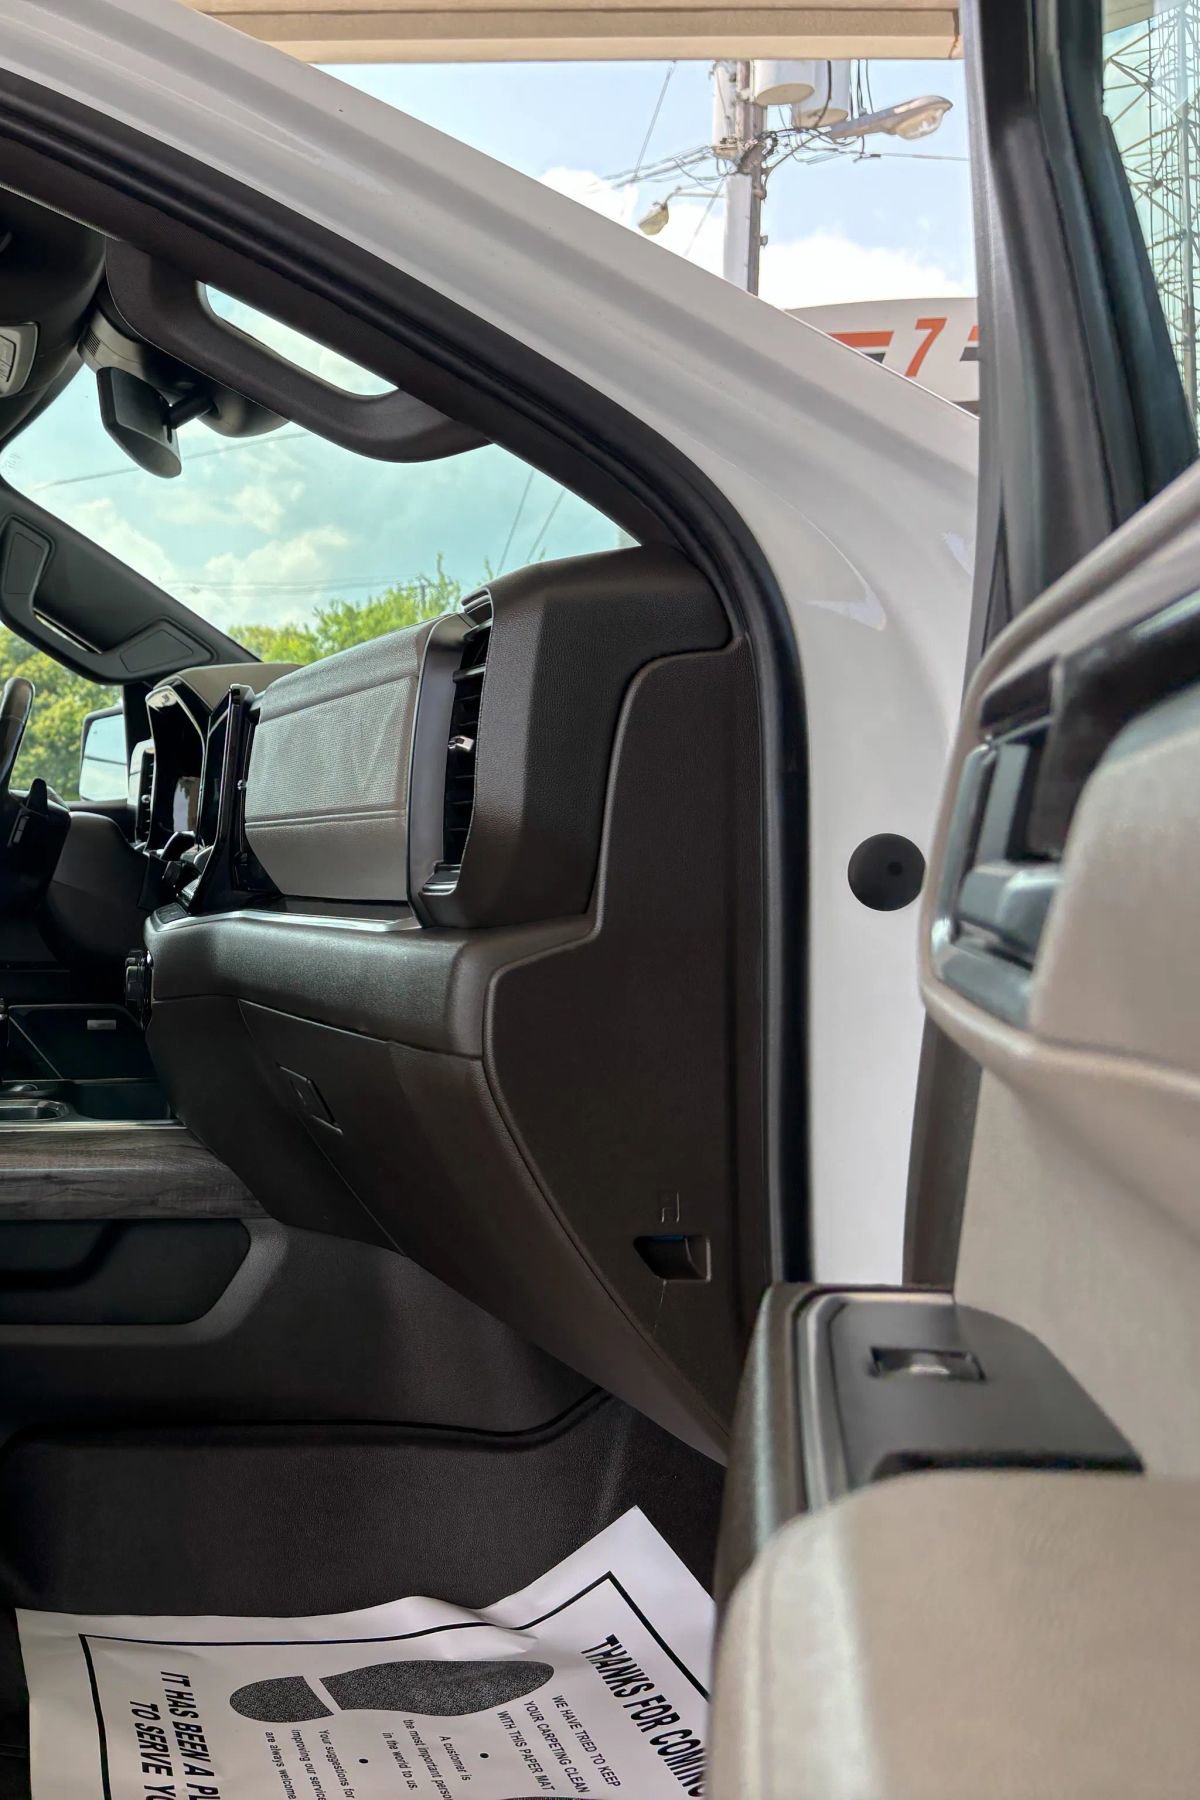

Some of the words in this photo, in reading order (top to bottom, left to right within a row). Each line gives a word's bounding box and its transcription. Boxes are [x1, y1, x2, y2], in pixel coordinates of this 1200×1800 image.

[905, 317, 947, 377] 7
[160, 1671, 191, 1687] IT
[580, 1633, 655, 1698] THANKS
[622, 1694, 681, 1733] FOR
[129, 1701, 161, 1720] TO
[164, 1689, 199, 1719] HAS
[552, 1695, 569, 1708] WE
[403, 1719, 415, 1729] the
[560, 1709, 583, 1730] HAVE
[172, 1721, 211, 1763] BEEN
[265, 1731, 276, 1743] are
[386, 1740, 399, 1750] the
[408, 1730, 426, 1746] most
[524, 1700, 545, 1723] YOUR
[537, 1723, 572, 1766] CARPETING
[564, 1766, 591, 1793] CLEAN
[575, 1729, 597, 1753] TRIED
[134, 1723, 173, 1776] SERVE
[270, 1744, 285, 1768] always
[291, 1729, 311, 1762] improving
[304, 1763, 317, 1775] our
[392, 1751, 412, 1769] world
[443, 1743, 468, 1773] customer
[497, 1710, 517, 1730] WITH
[508, 1730, 528, 1747] THIS
[518, 1748, 544, 1774] PAPER
[535, 1775, 556, 1791] MAT
[590, 1753, 606, 1765] TO
[183, 1762, 214, 1776] A
[318, 1729, 332, 1745] Your
[325, 1746, 350, 1787] suggestions
[343, 1788, 355, 1799] for
[401, 1770, 413, 1778] to
[418, 1747, 442, 1778] important
[278, 1768, 297, 1800] welcome
[406, 1780, 418, 1791] us.
[597, 1765, 621, 1787] KEEP
